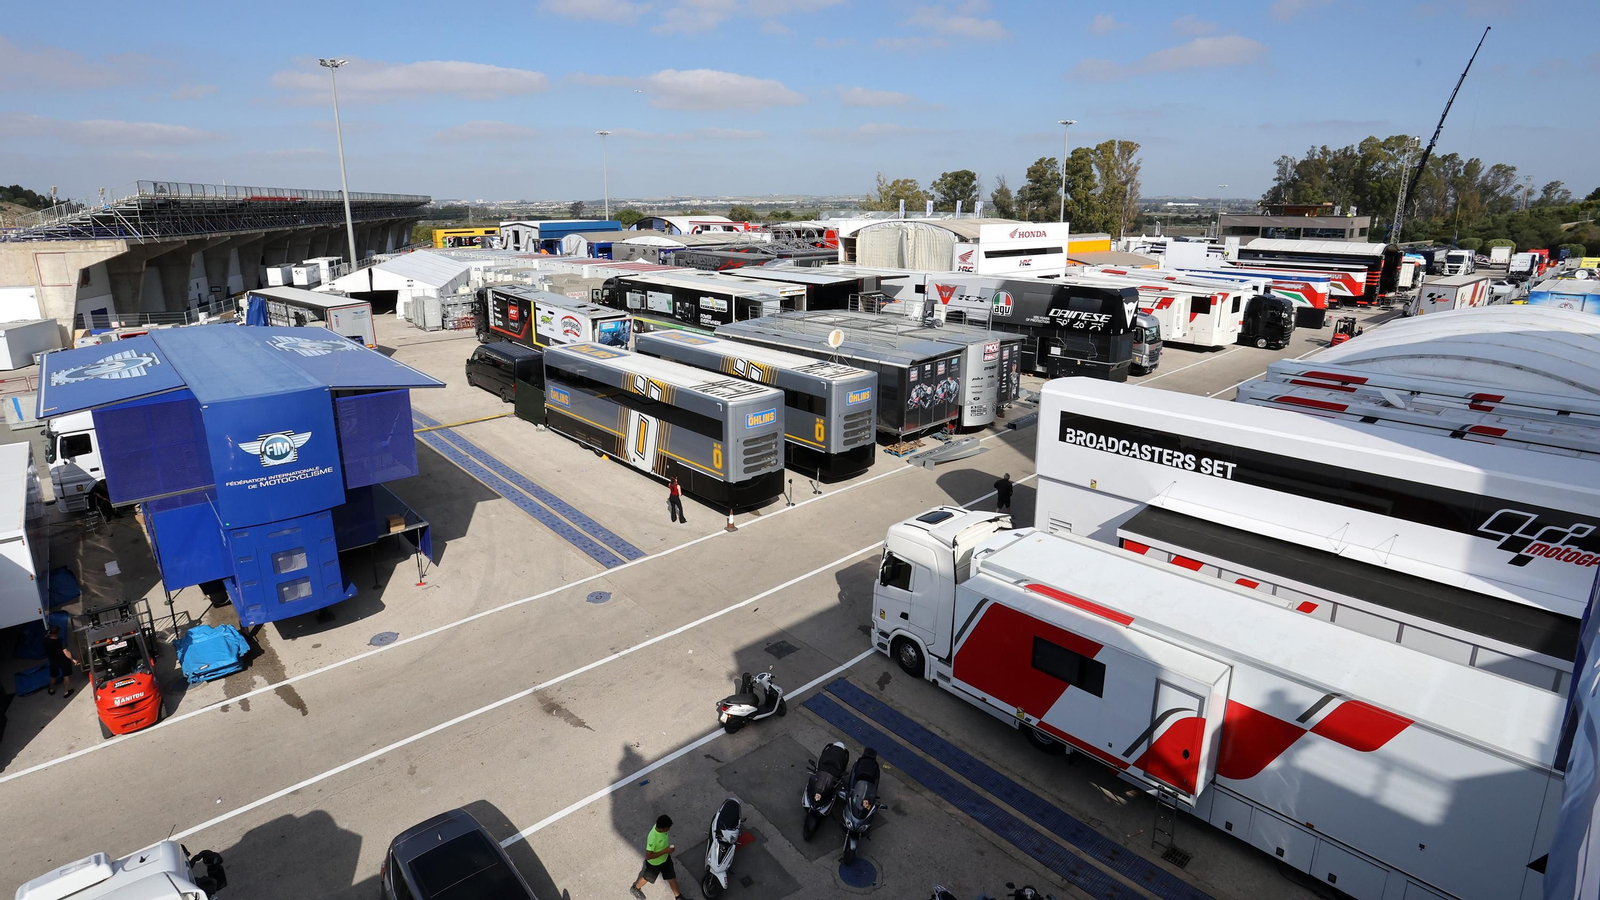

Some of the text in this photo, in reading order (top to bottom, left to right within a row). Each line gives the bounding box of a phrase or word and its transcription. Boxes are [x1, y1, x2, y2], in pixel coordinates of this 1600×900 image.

[1018, 231, 1047, 239] HONDA
[1019, 259, 1032, 267] HRC
[958, 294, 987, 303] TCX
[994, 305, 1011, 316] agv
[1048, 308, 1113, 323] DAINESE
[550, 386, 569, 407] ÖHLINS
[848, 388, 871, 405] ÖHLINS
[747, 410, 775, 428] ÖHLINS
[266, 441, 290, 456] FIM
[1065, 427, 1237, 480] BROADCASTERS SET
[225, 466, 320, 487] FÉDÉRATION INTERNATIONALE
[259, 466, 334, 488] MOTOCYCLISME
[114, 692, 145, 705] MANITOU
